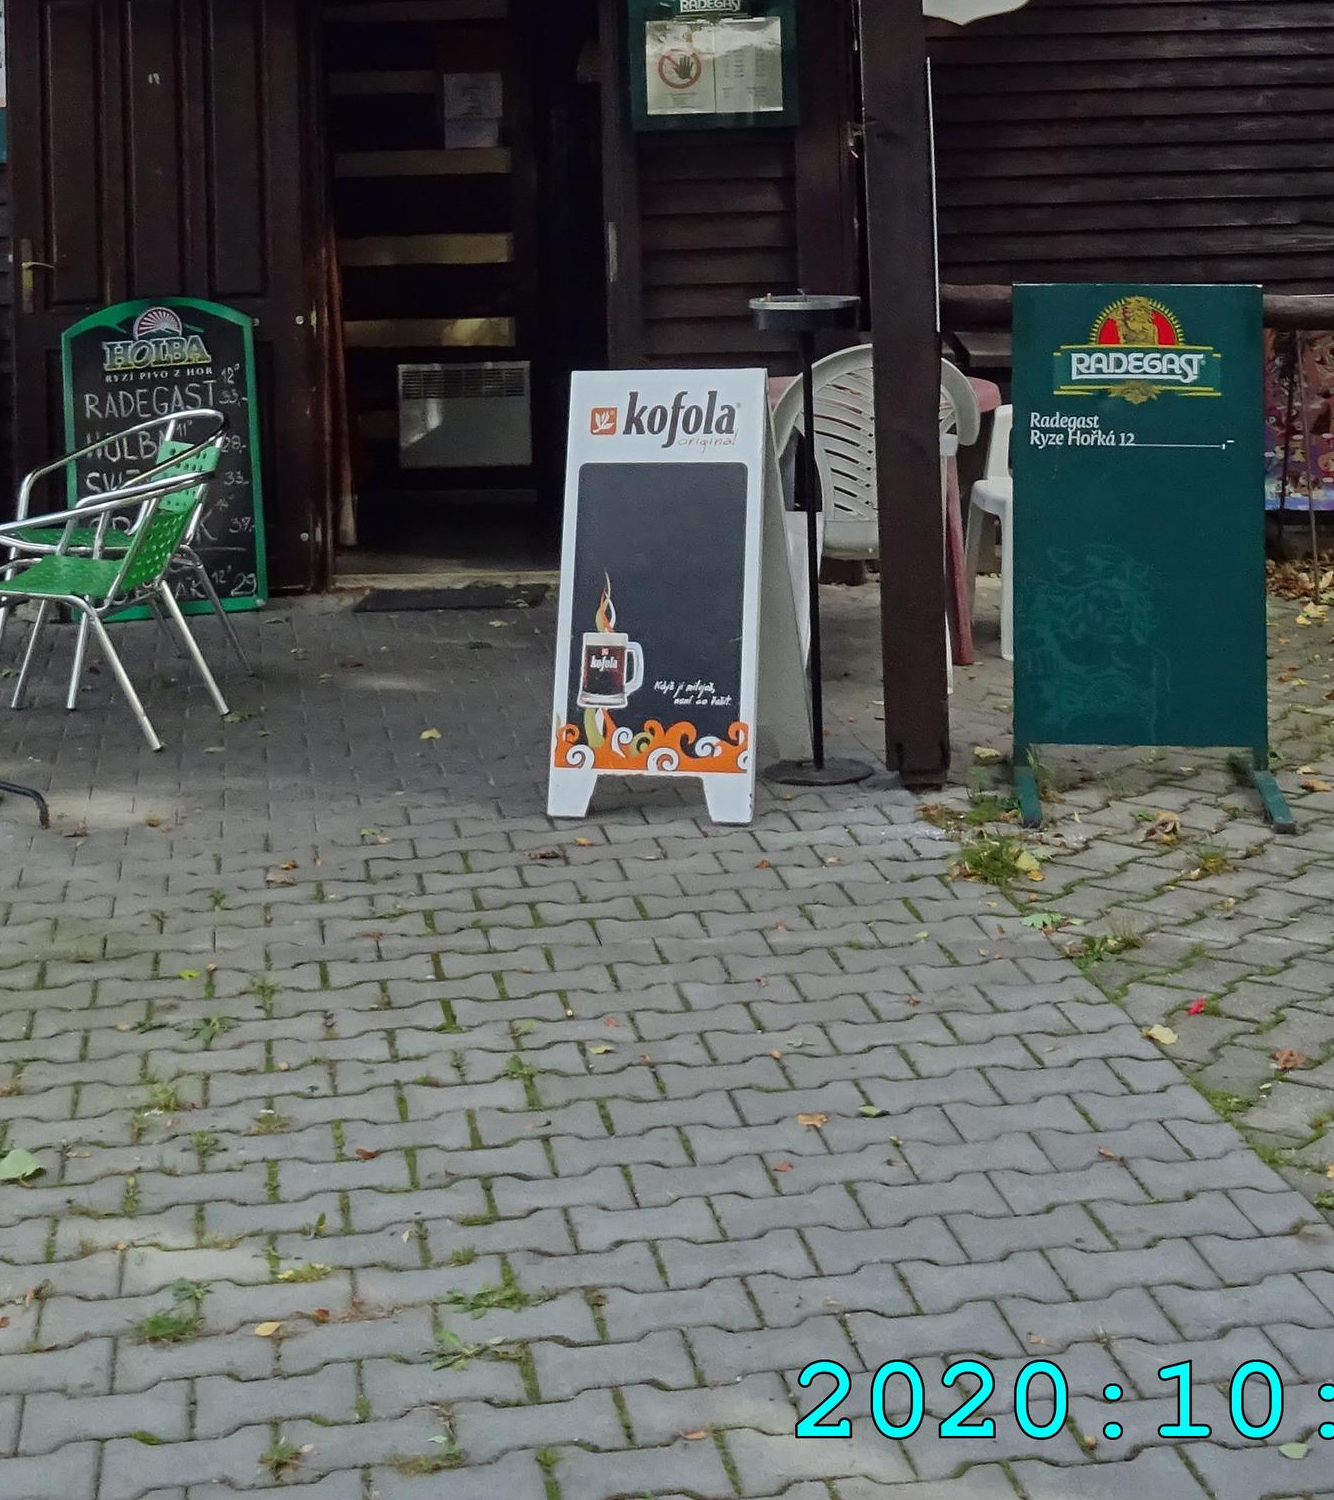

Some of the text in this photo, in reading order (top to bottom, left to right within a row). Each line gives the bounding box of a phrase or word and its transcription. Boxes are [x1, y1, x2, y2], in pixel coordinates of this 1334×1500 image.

[102, 335, 212, 372] HOLBA
[139, 371, 168, 380] PIVO
[173, 370, 180, 378] Z
[186, 366, 213, 377] HOR
[1071, 352, 1204, 384] RADEGAST
[84, 380, 216, 420] RADEGAST
[622, 390, 736, 449] kofola
[1030, 412, 1099, 432] Radegast
[677, 429, 739, 453] original
[1029, 429, 1063, 449] Ryze
[1067, 429, 1116, 446] Hořká
[1119, 433, 1135, 446] 12
[590, 655, 618, 672] kofola
